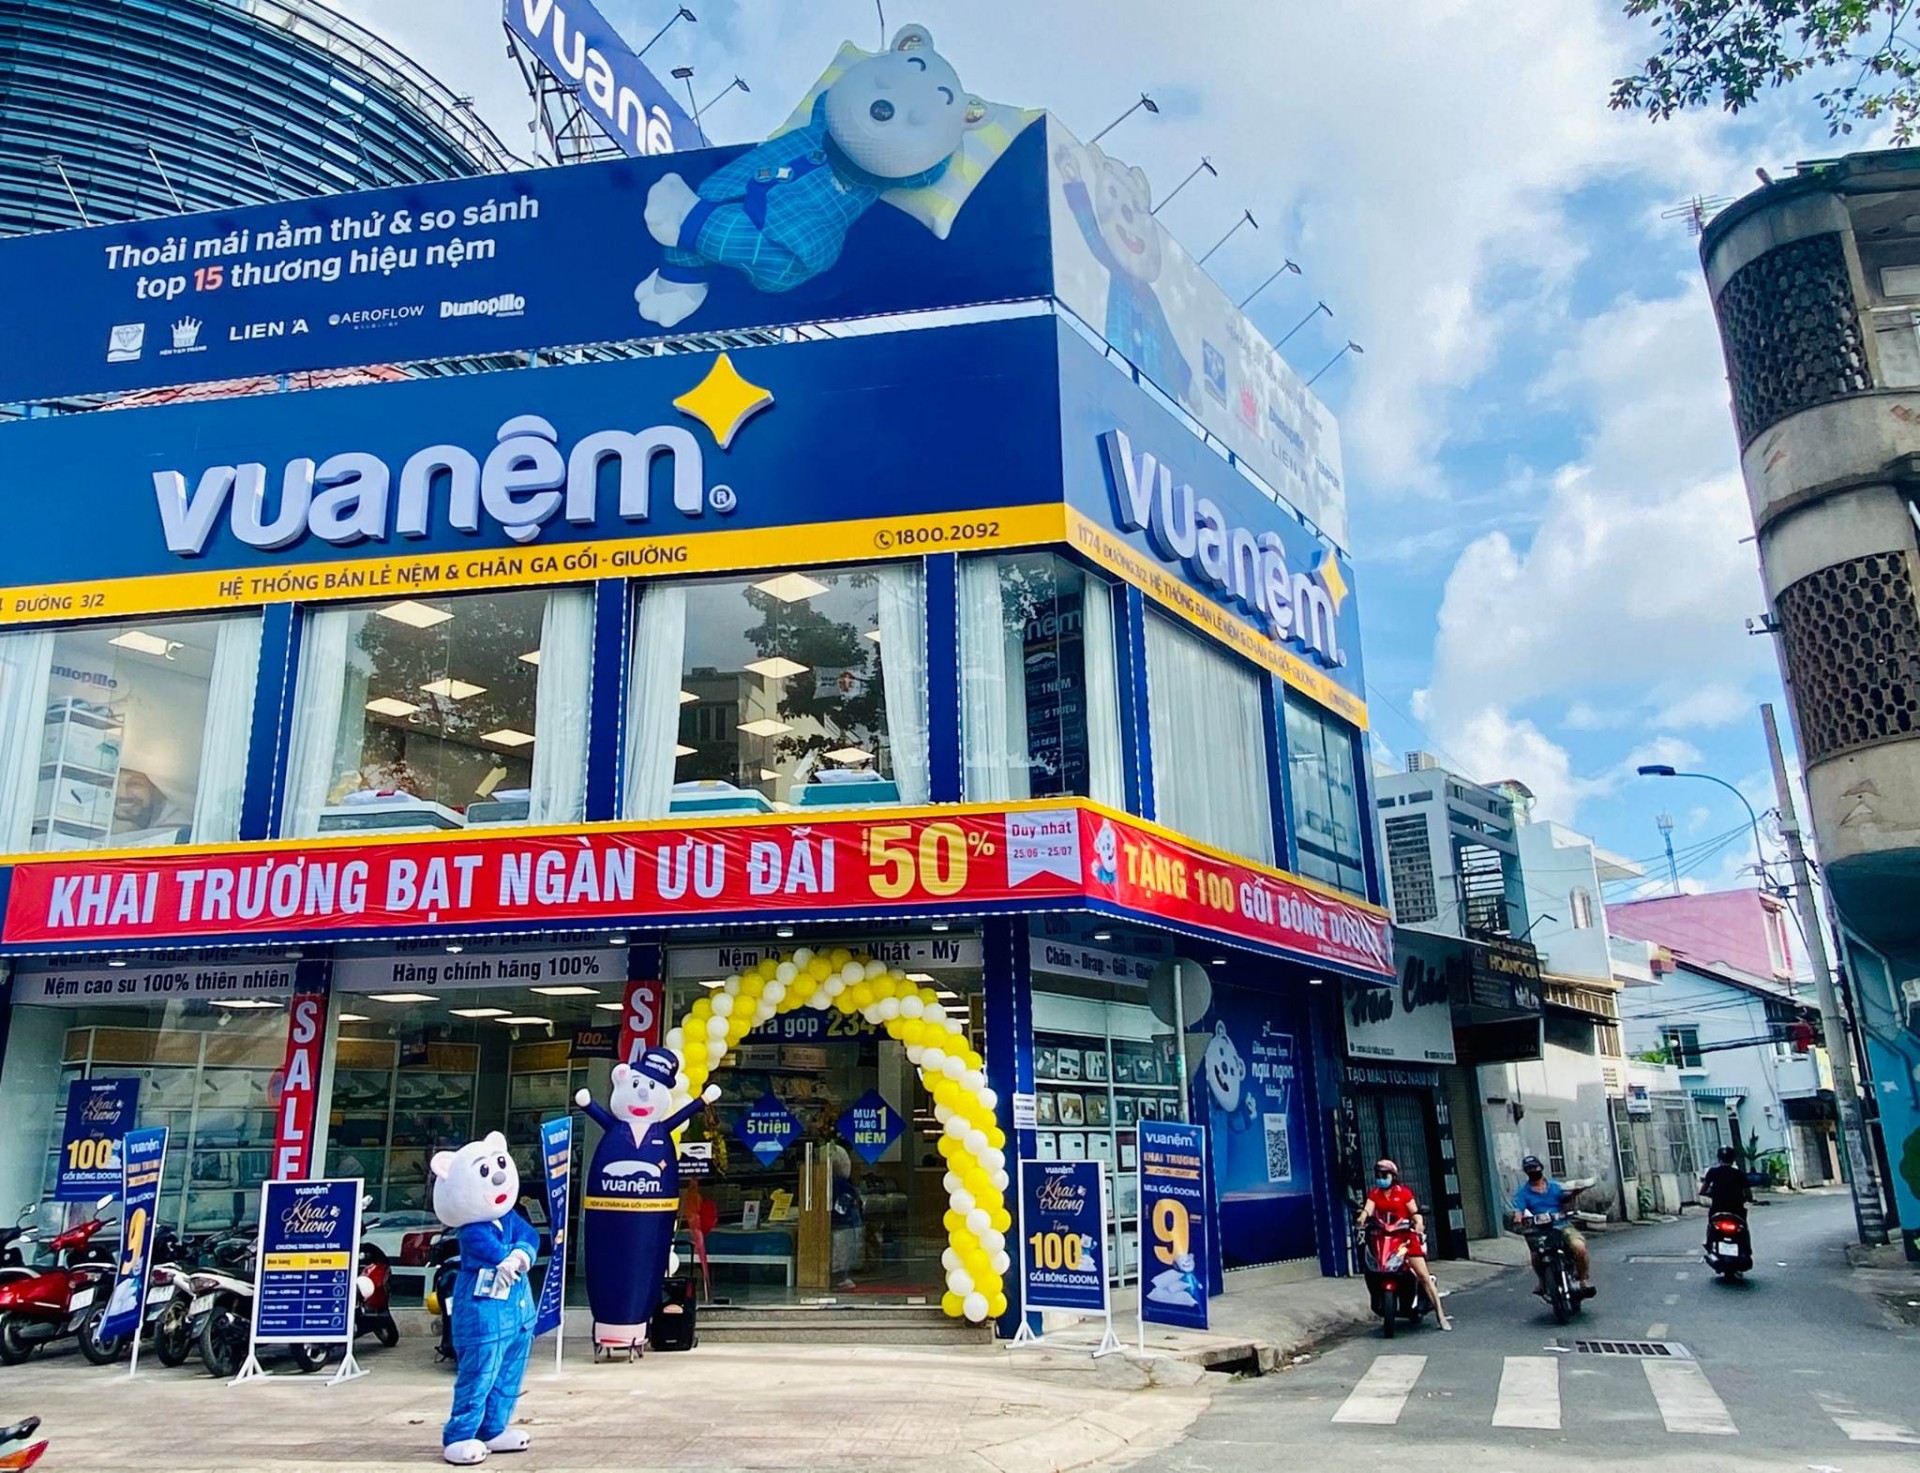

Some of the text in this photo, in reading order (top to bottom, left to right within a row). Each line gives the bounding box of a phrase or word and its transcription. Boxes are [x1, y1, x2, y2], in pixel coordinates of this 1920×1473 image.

[105, 196, 540, 270] Thoải mái nằm thử & so sánh
[136, 237, 496, 300] top 15 thương hiệu nệm
[340, 304, 425, 324] AEROFLOW
[230, 321, 285, 341] LIEN
[152, 414, 703, 556] vuanệm
[896, 522, 1000, 545] 1800.2092
[219, 546, 688, 600] HỆ THỐNG BÁN LẺ NỆM & CHĂN GA GỐI GIƯỜNG
[15, 593, 105, 613] ĐƯỜNG 3/2
[1012, 817, 1073, 840] Duy nhất
[47, 872, 161, 928] KHAI
[176, 856, 369, 922] TRƯƠNG
[385, 855, 484, 922] BẠT
[500, 836, 637, 907] NGÀN
[657, 837, 728, 900] ƯU
[746, 826, 836, 896] ĐÃI
[868, 822, 996, 899] 50%
[1123, 841, 1189, 900] TẶNG
[1194, 868, 1235, 914] 100
[1239, 873, 1274, 926] GỐI
[1278, 889, 1326, 939] BÔNG
[719, 947, 758, 971] Nệm
[867, 940, 910, 966] Nhật
[932, 940, 960, 963] Mỹ
[1046, 945, 1071, 967] Chăn
[1081, 952, 1104, 975] Drap
[392, 956, 600, 985] Hàng chính hãng 100%
[44, 970, 290, 999] Nệm cao su 100% thiên nhiên
[1272, 1063, 1294, 1085] ngon
[747, 1119, 791, 1137] 5 triệu
[853, 1107, 887, 1130] MUA 1
[854, 1130, 886, 1148] NỆM
[1145, 1132, 1193, 1147] vuanệm
[67, 1139, 113, 1170] 100
[602, 1178, 660, 1195] vuanệm
[1036, 1175, 1076, 1200] Khai
[1159, 1184, 1173, 1194] GỐI
[281, 1195, 329, 1222] Khai
[1152, 1198, 1190, 1265] 9
[1029, 1232, 1083, 1271] 100
[1030, 1270, 1100, 1285] GỐI BÔNG DOONA
